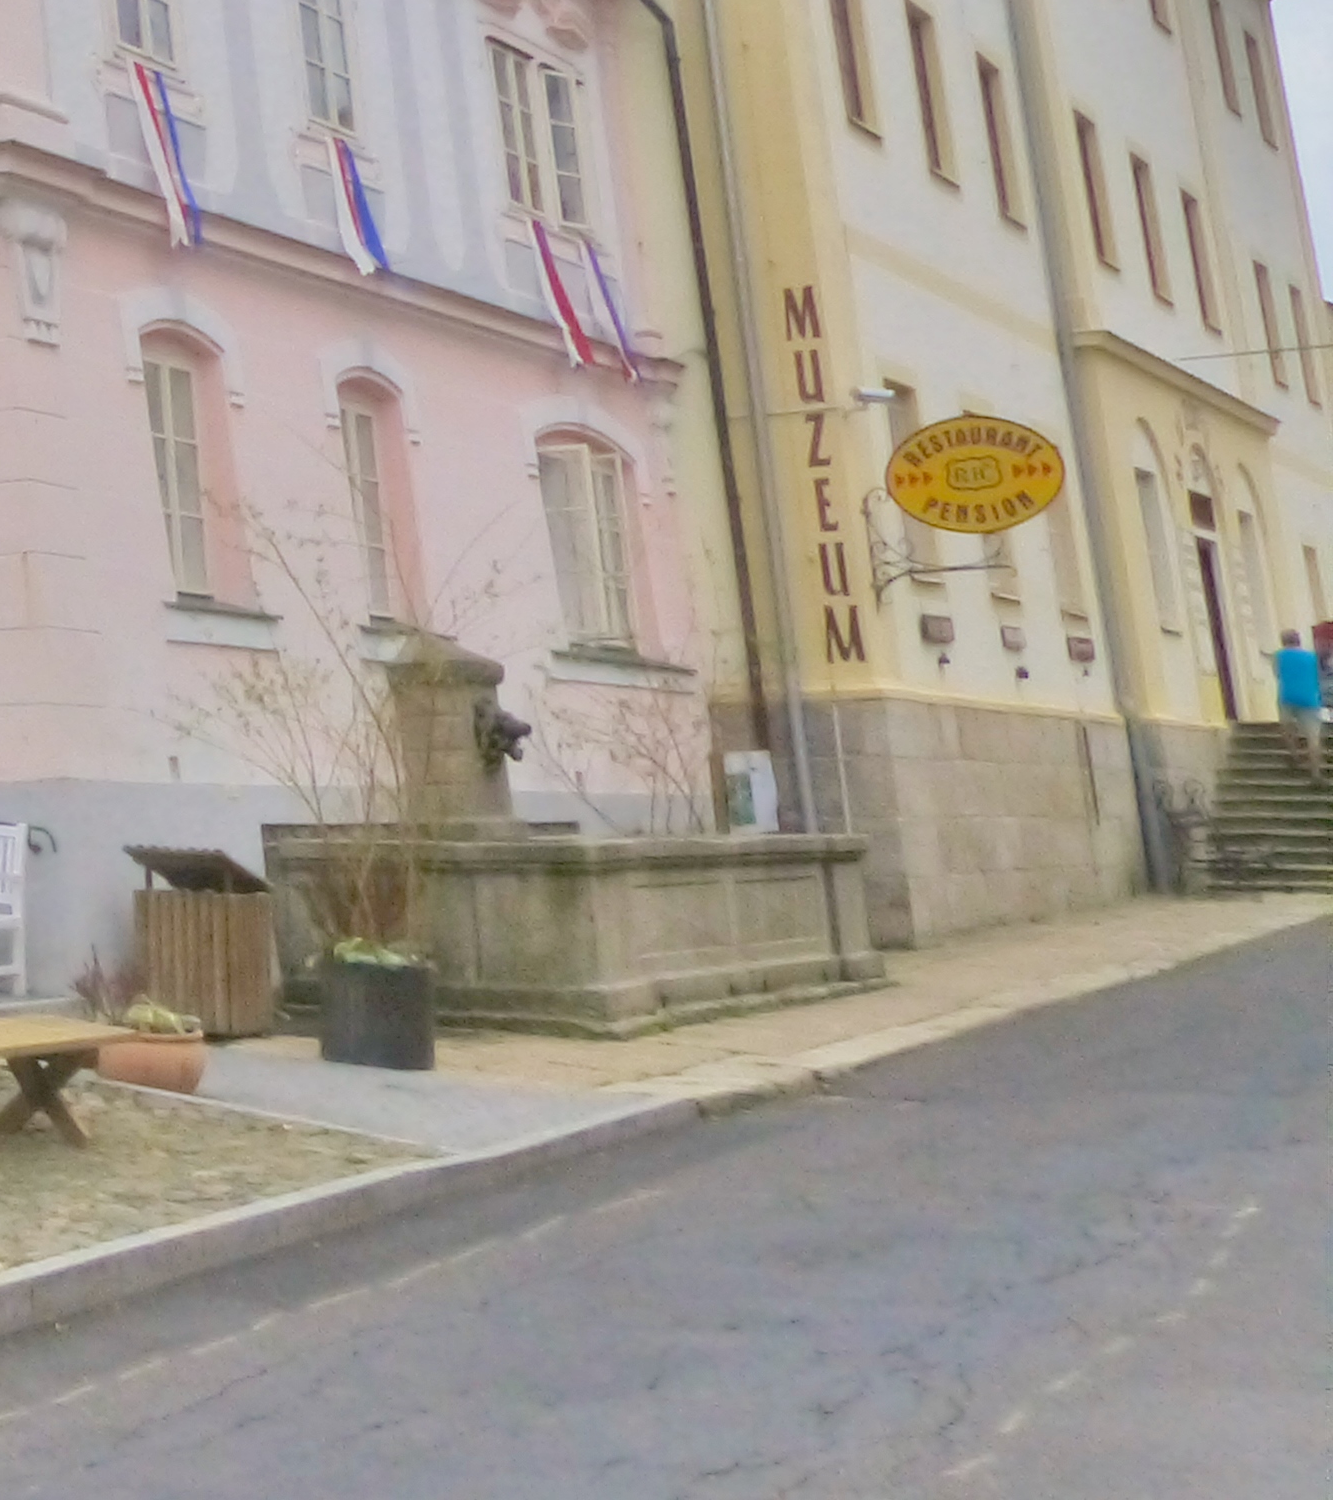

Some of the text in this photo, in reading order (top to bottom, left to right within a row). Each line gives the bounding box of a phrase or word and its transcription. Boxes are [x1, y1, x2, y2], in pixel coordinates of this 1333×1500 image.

[902, 426, 1044, 467] RESTAURANT
[783, 285, 866, 663] MUZEUM
[922, 490, 1035, 524] PENSION
